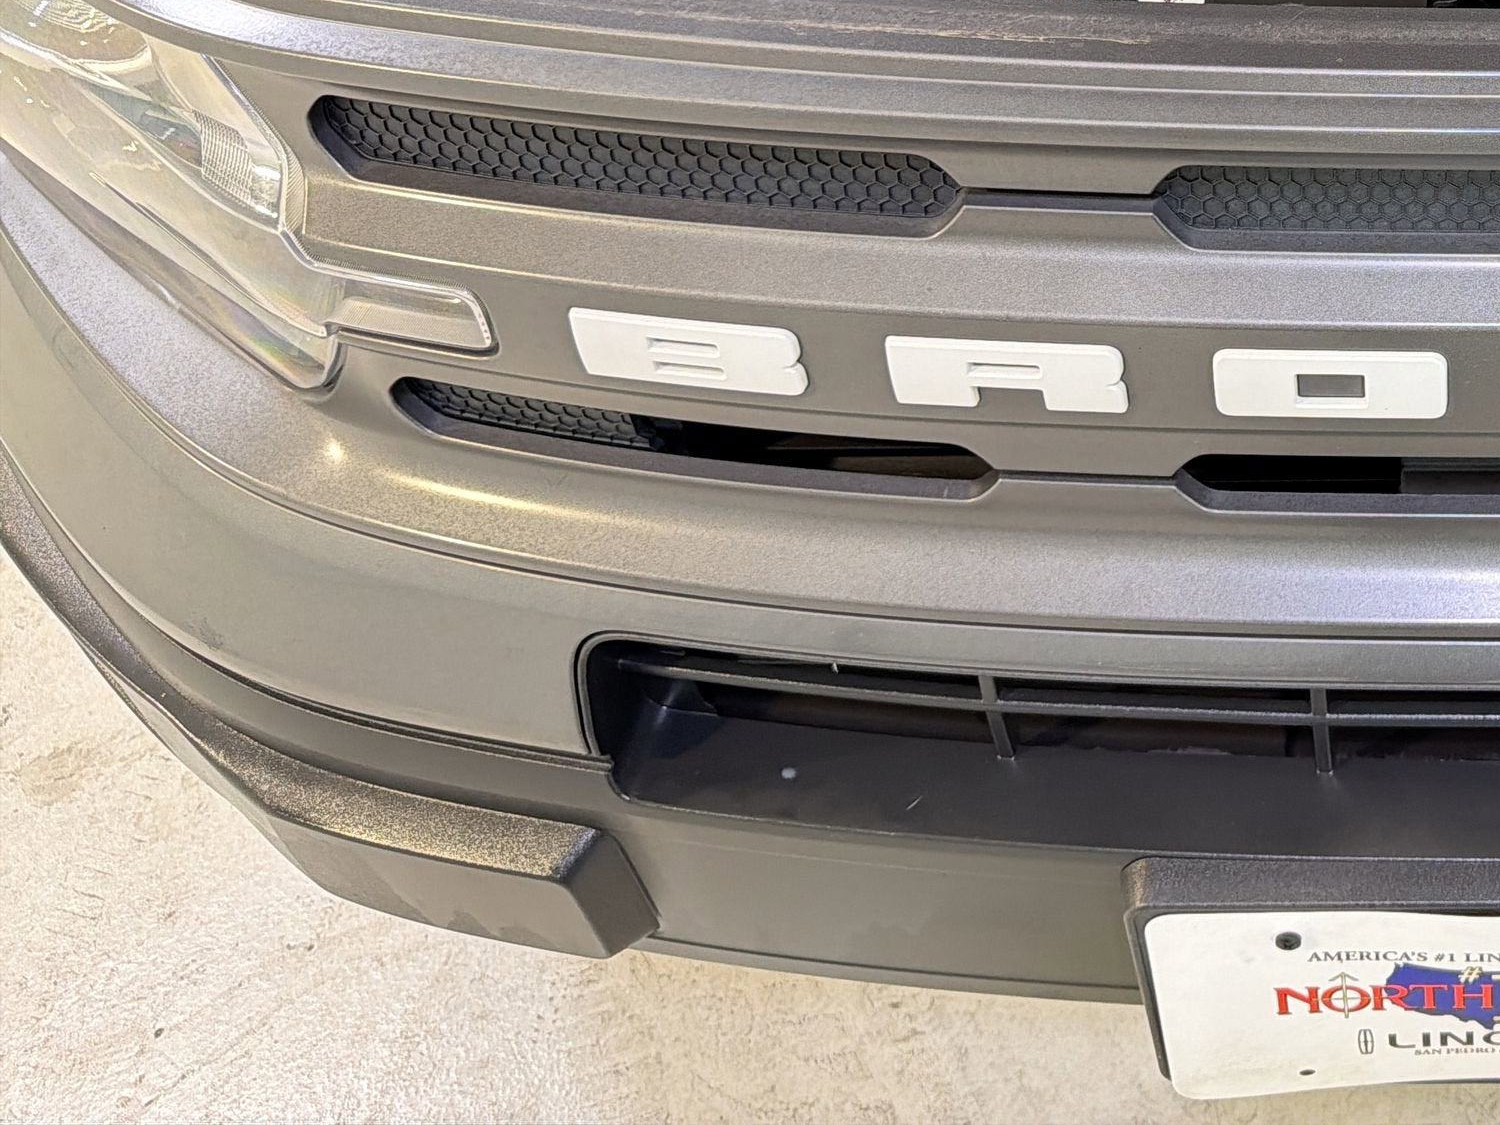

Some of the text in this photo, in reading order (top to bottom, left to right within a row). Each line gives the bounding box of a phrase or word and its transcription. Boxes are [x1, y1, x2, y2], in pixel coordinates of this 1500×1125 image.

[1307, 950, 1429, 963] AMERICA'S
[1434, 952, 1456, 963] #1
[1273, 982, 1494, 1015] NORTH
[1414, 1047, 1442, 1056] SAN
[1446, 1047, 1496, 1055] PEDRO
